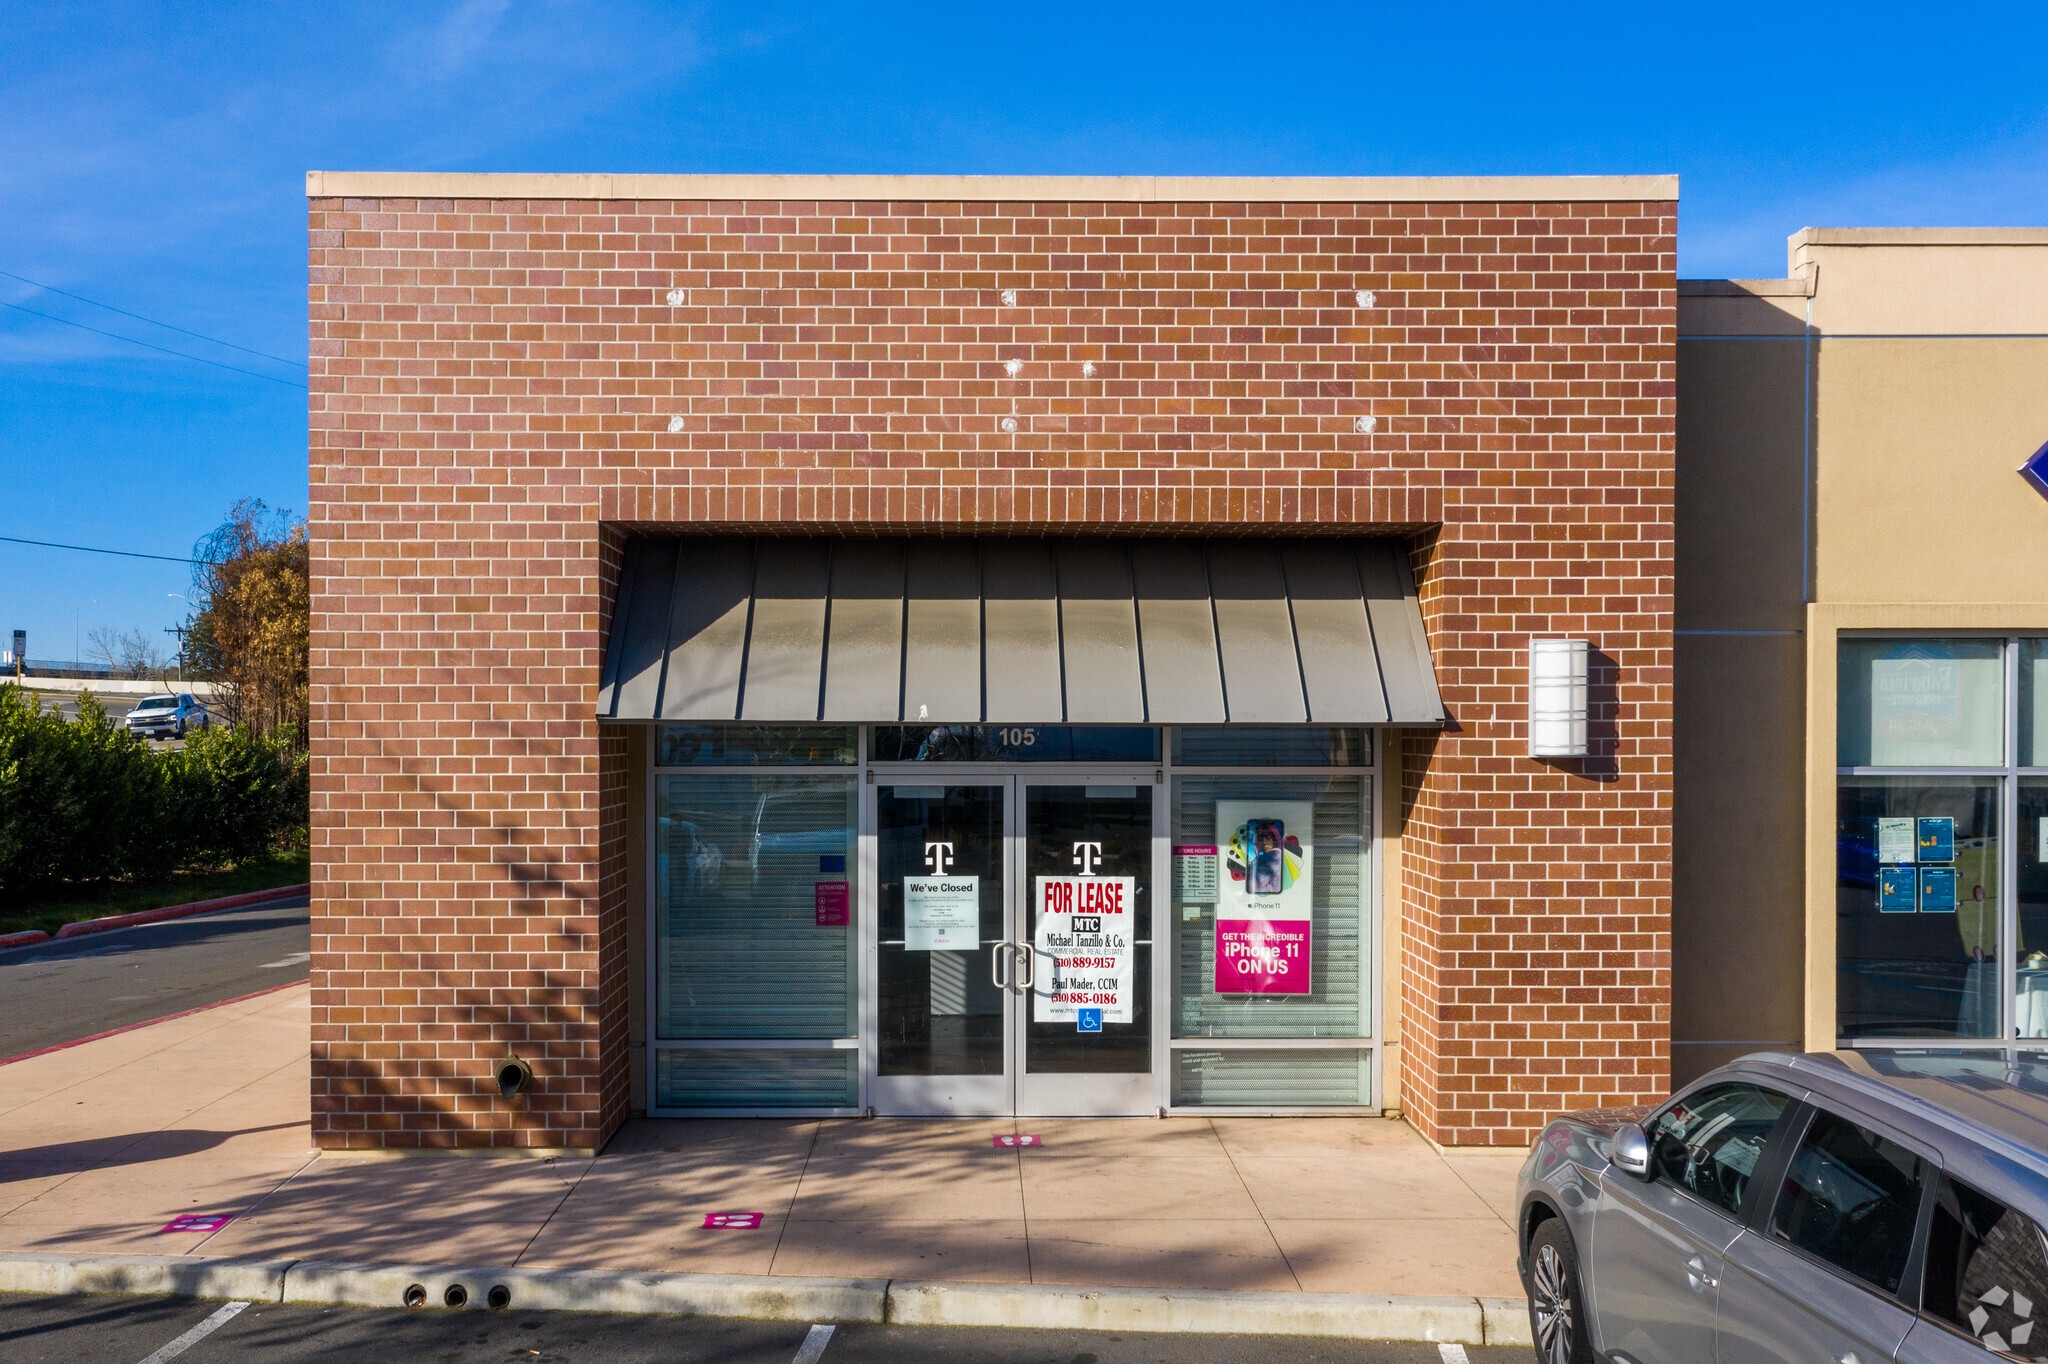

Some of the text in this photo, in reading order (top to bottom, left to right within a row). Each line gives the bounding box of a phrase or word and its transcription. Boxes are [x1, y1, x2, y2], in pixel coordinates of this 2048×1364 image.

[999, 728, 1036, 746] 105
[910, 883, 973, 893] We've Closed
[1044, 882, 1123, 914] FOR LEASE
[1073, 918, 1099, 931] MTC
[1047, 933, 1125, 948] Michael Tanzillo & Co.
[1222, 932, 1304, 941] GET THE INCREDIBLE
[1047, 947, 1084, 955] COMMERCIAL
[1104, 948, 1124, 956] ESTATE
[1225, 942, 1299, 957] iPhone 11
[1053, 957, 1116, 969] (510) 889-9157
[1237, 959, 1289, 974] ON US
[1052, 977, 1118, 990] Paul Mader, CCIM
[1051, 992, 1117, 1004] (510) 885-0186
